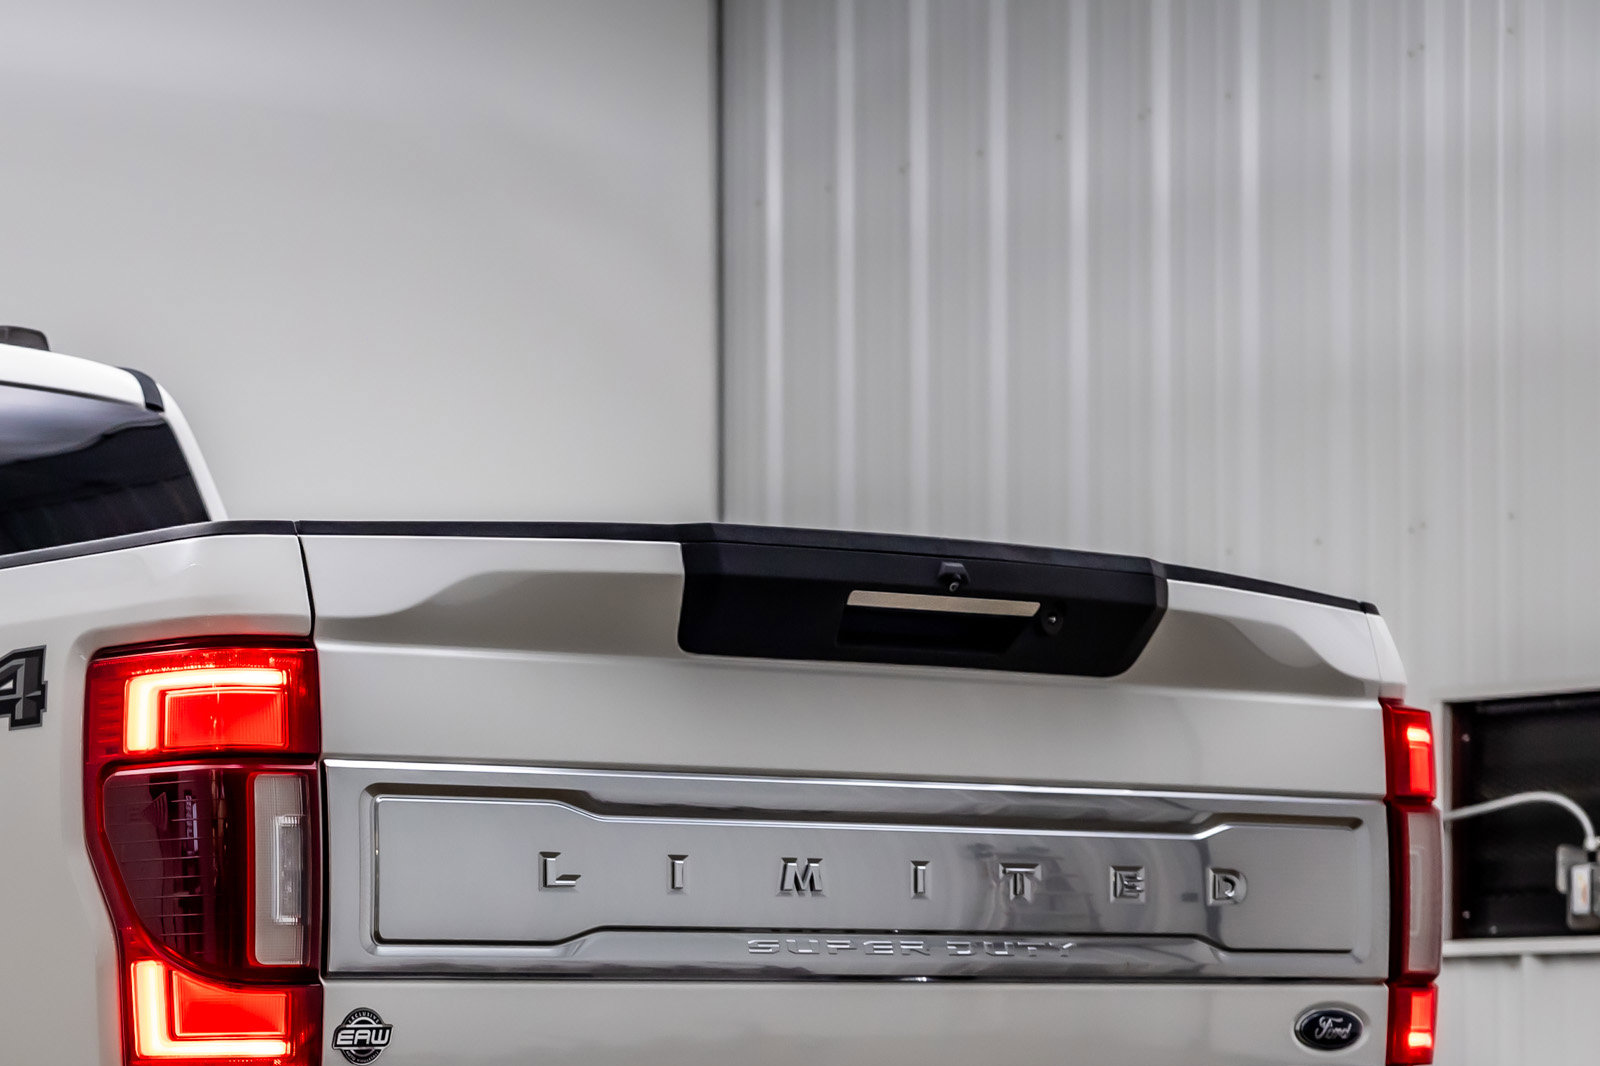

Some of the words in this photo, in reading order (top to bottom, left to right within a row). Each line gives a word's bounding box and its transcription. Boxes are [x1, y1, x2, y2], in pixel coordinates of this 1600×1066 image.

[538, 851, 1248, 906] LIMITED
[747, 939, 931, 957] SUPER
[946, 940, 1077, 958] DUTY
[336, 1029, 390, 1045] EAW
[1314, 1015, 1353, 1040] Ford
